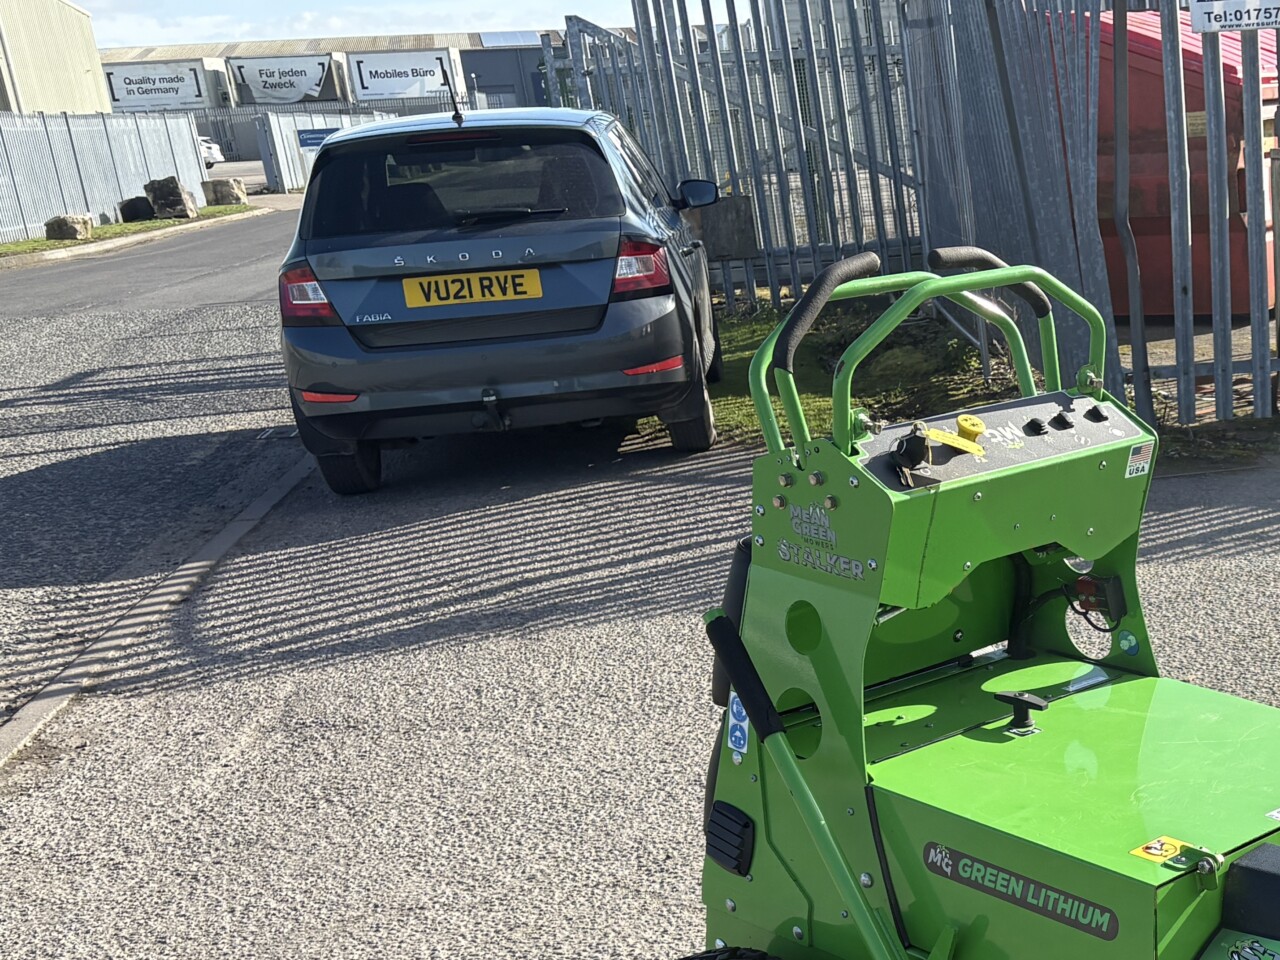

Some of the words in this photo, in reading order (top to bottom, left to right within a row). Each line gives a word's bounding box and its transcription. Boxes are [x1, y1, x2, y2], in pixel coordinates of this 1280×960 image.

[1203, 7, 1280, 23] Tel:01757
[259, 69, 277, 79] Für
[278, 68, 307, 80] jeden
[369, 70, 409, 80] Mobiles
[411, 67, 436, 78] Büro
[123, 76, 156, 87] Quality
[158, 75, 185, 84] made
[262, 80, 296, 90] Zweck
[126, 87, 135, 96] in
[137, 85, 179, 96] Germany
[419, 277, 474, 303] VU21
[479, 274, 528, 298] RVE
[356, 313, 392, 322] FABIA
[1128, 465, 1146, 476] USA
[789, 503, 830, 528] MEAN
[791, 518, 837, 544] GREEN
[778, 538, 865, 581] STALKER
[958, 858, 1024, 899] GREEN
[1027, 884, 1111, 932] LITHIUM
